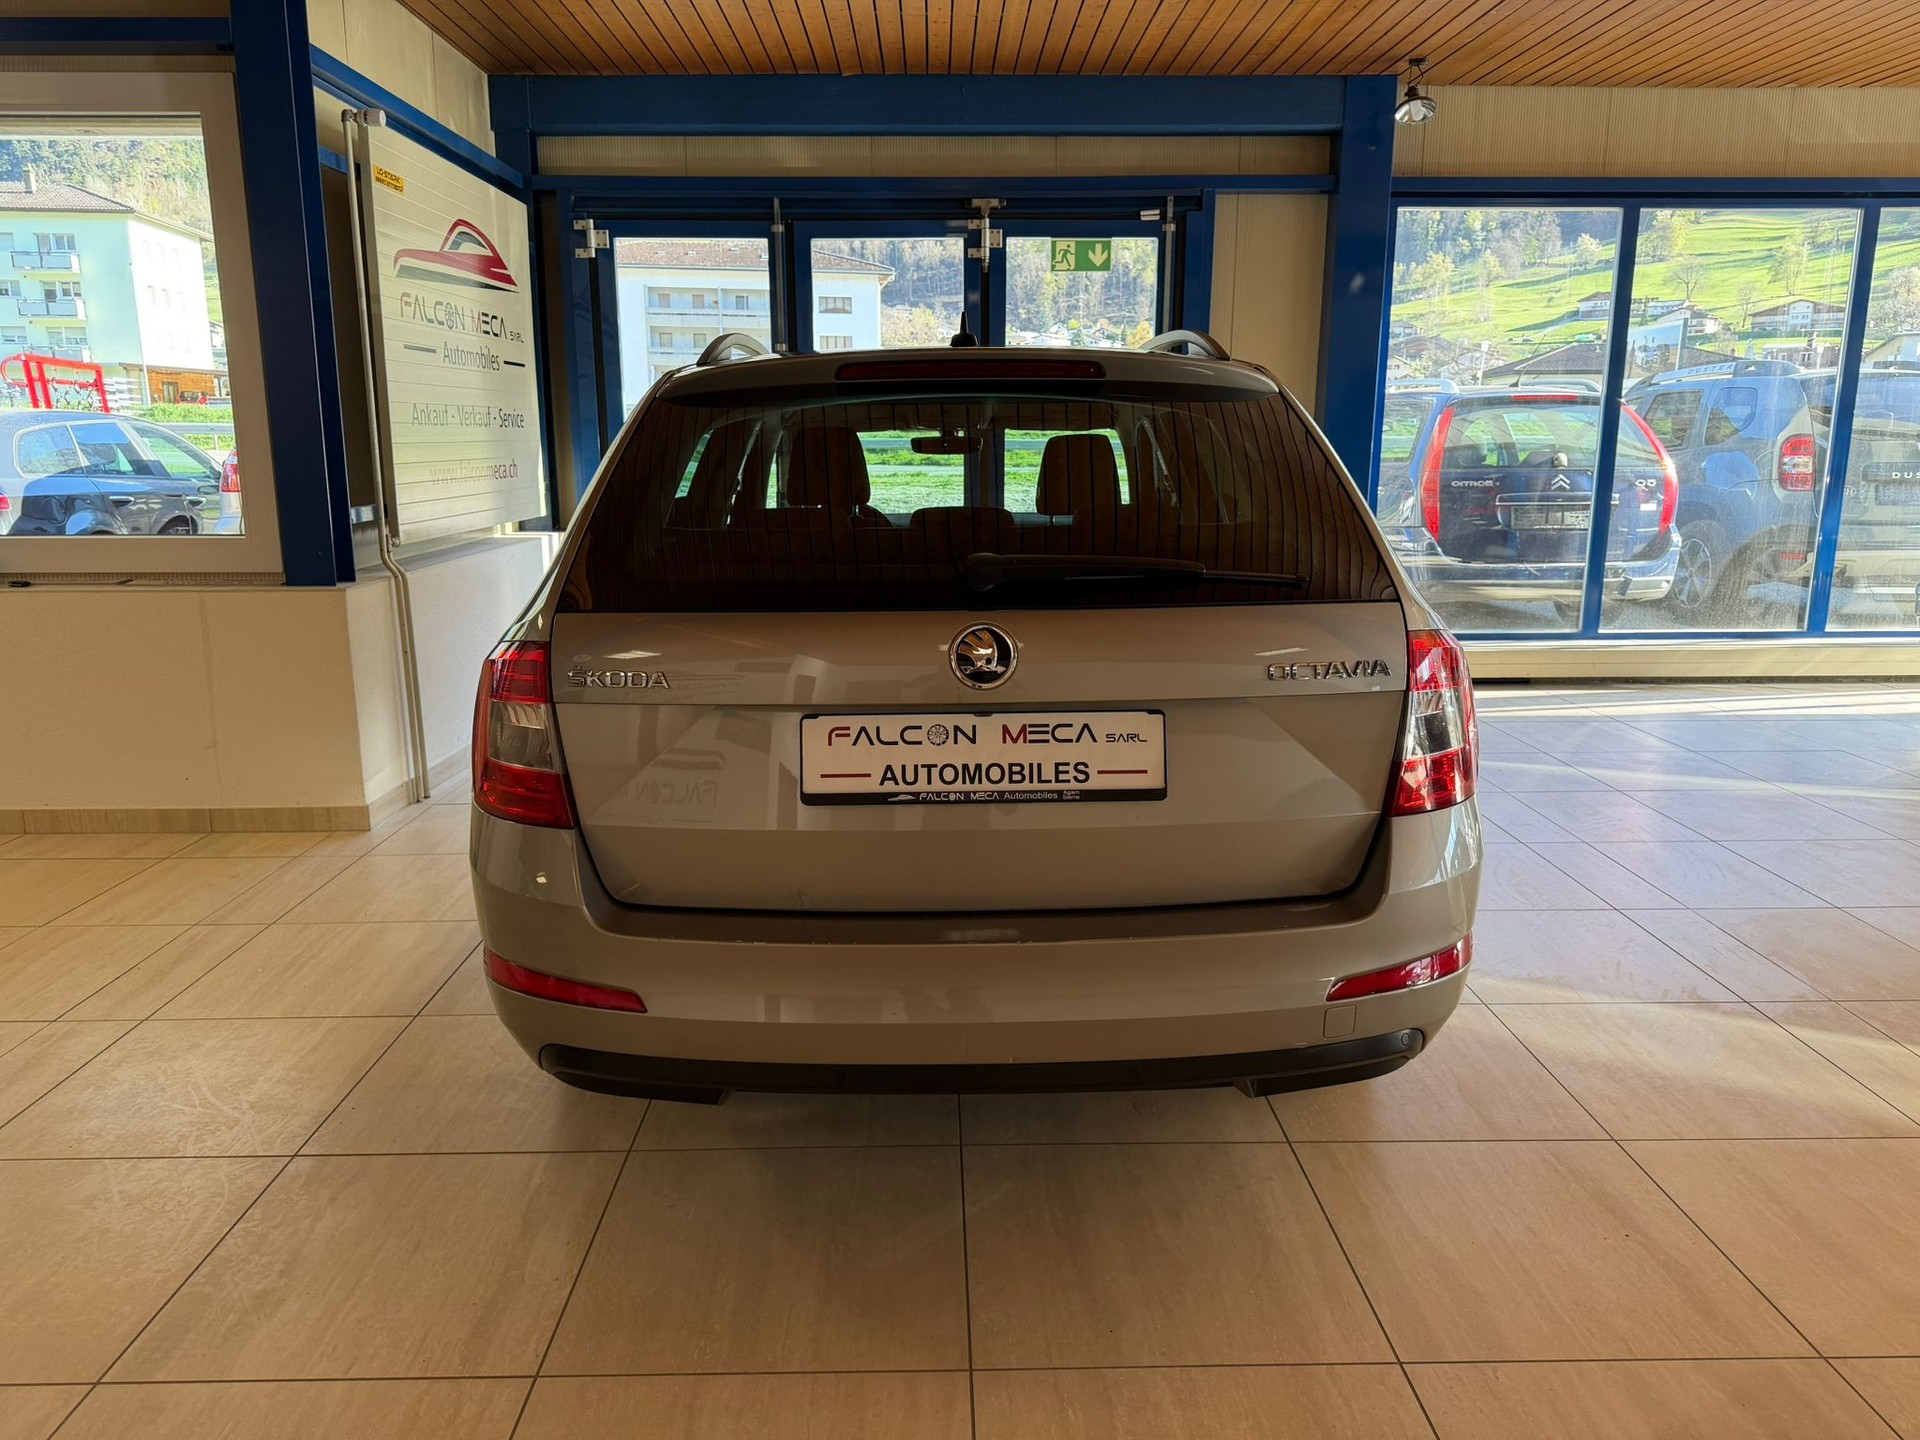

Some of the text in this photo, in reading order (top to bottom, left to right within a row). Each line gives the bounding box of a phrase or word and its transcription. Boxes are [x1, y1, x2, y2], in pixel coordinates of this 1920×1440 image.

[401, 291, 466, 331] FALCON
[470, 309, 508, 340] MECA
[443, 341, 501, 372] Automobiles
[412, 402, 449, 427] Ankauf
[457, 405, 491, 428] Verkauf
[498, 408, 525, 429] Service
[567, 666, 671, 689] ŠKODA
[1267, 660, 1392, 681] OCTAVIA
[827, 723, 1148, 747] FALCON MECA SARL
[879, 761, 1091, 787] AUTOMOBILES
[919, 791, 1058, 801] FALCON MECA Automobiles
